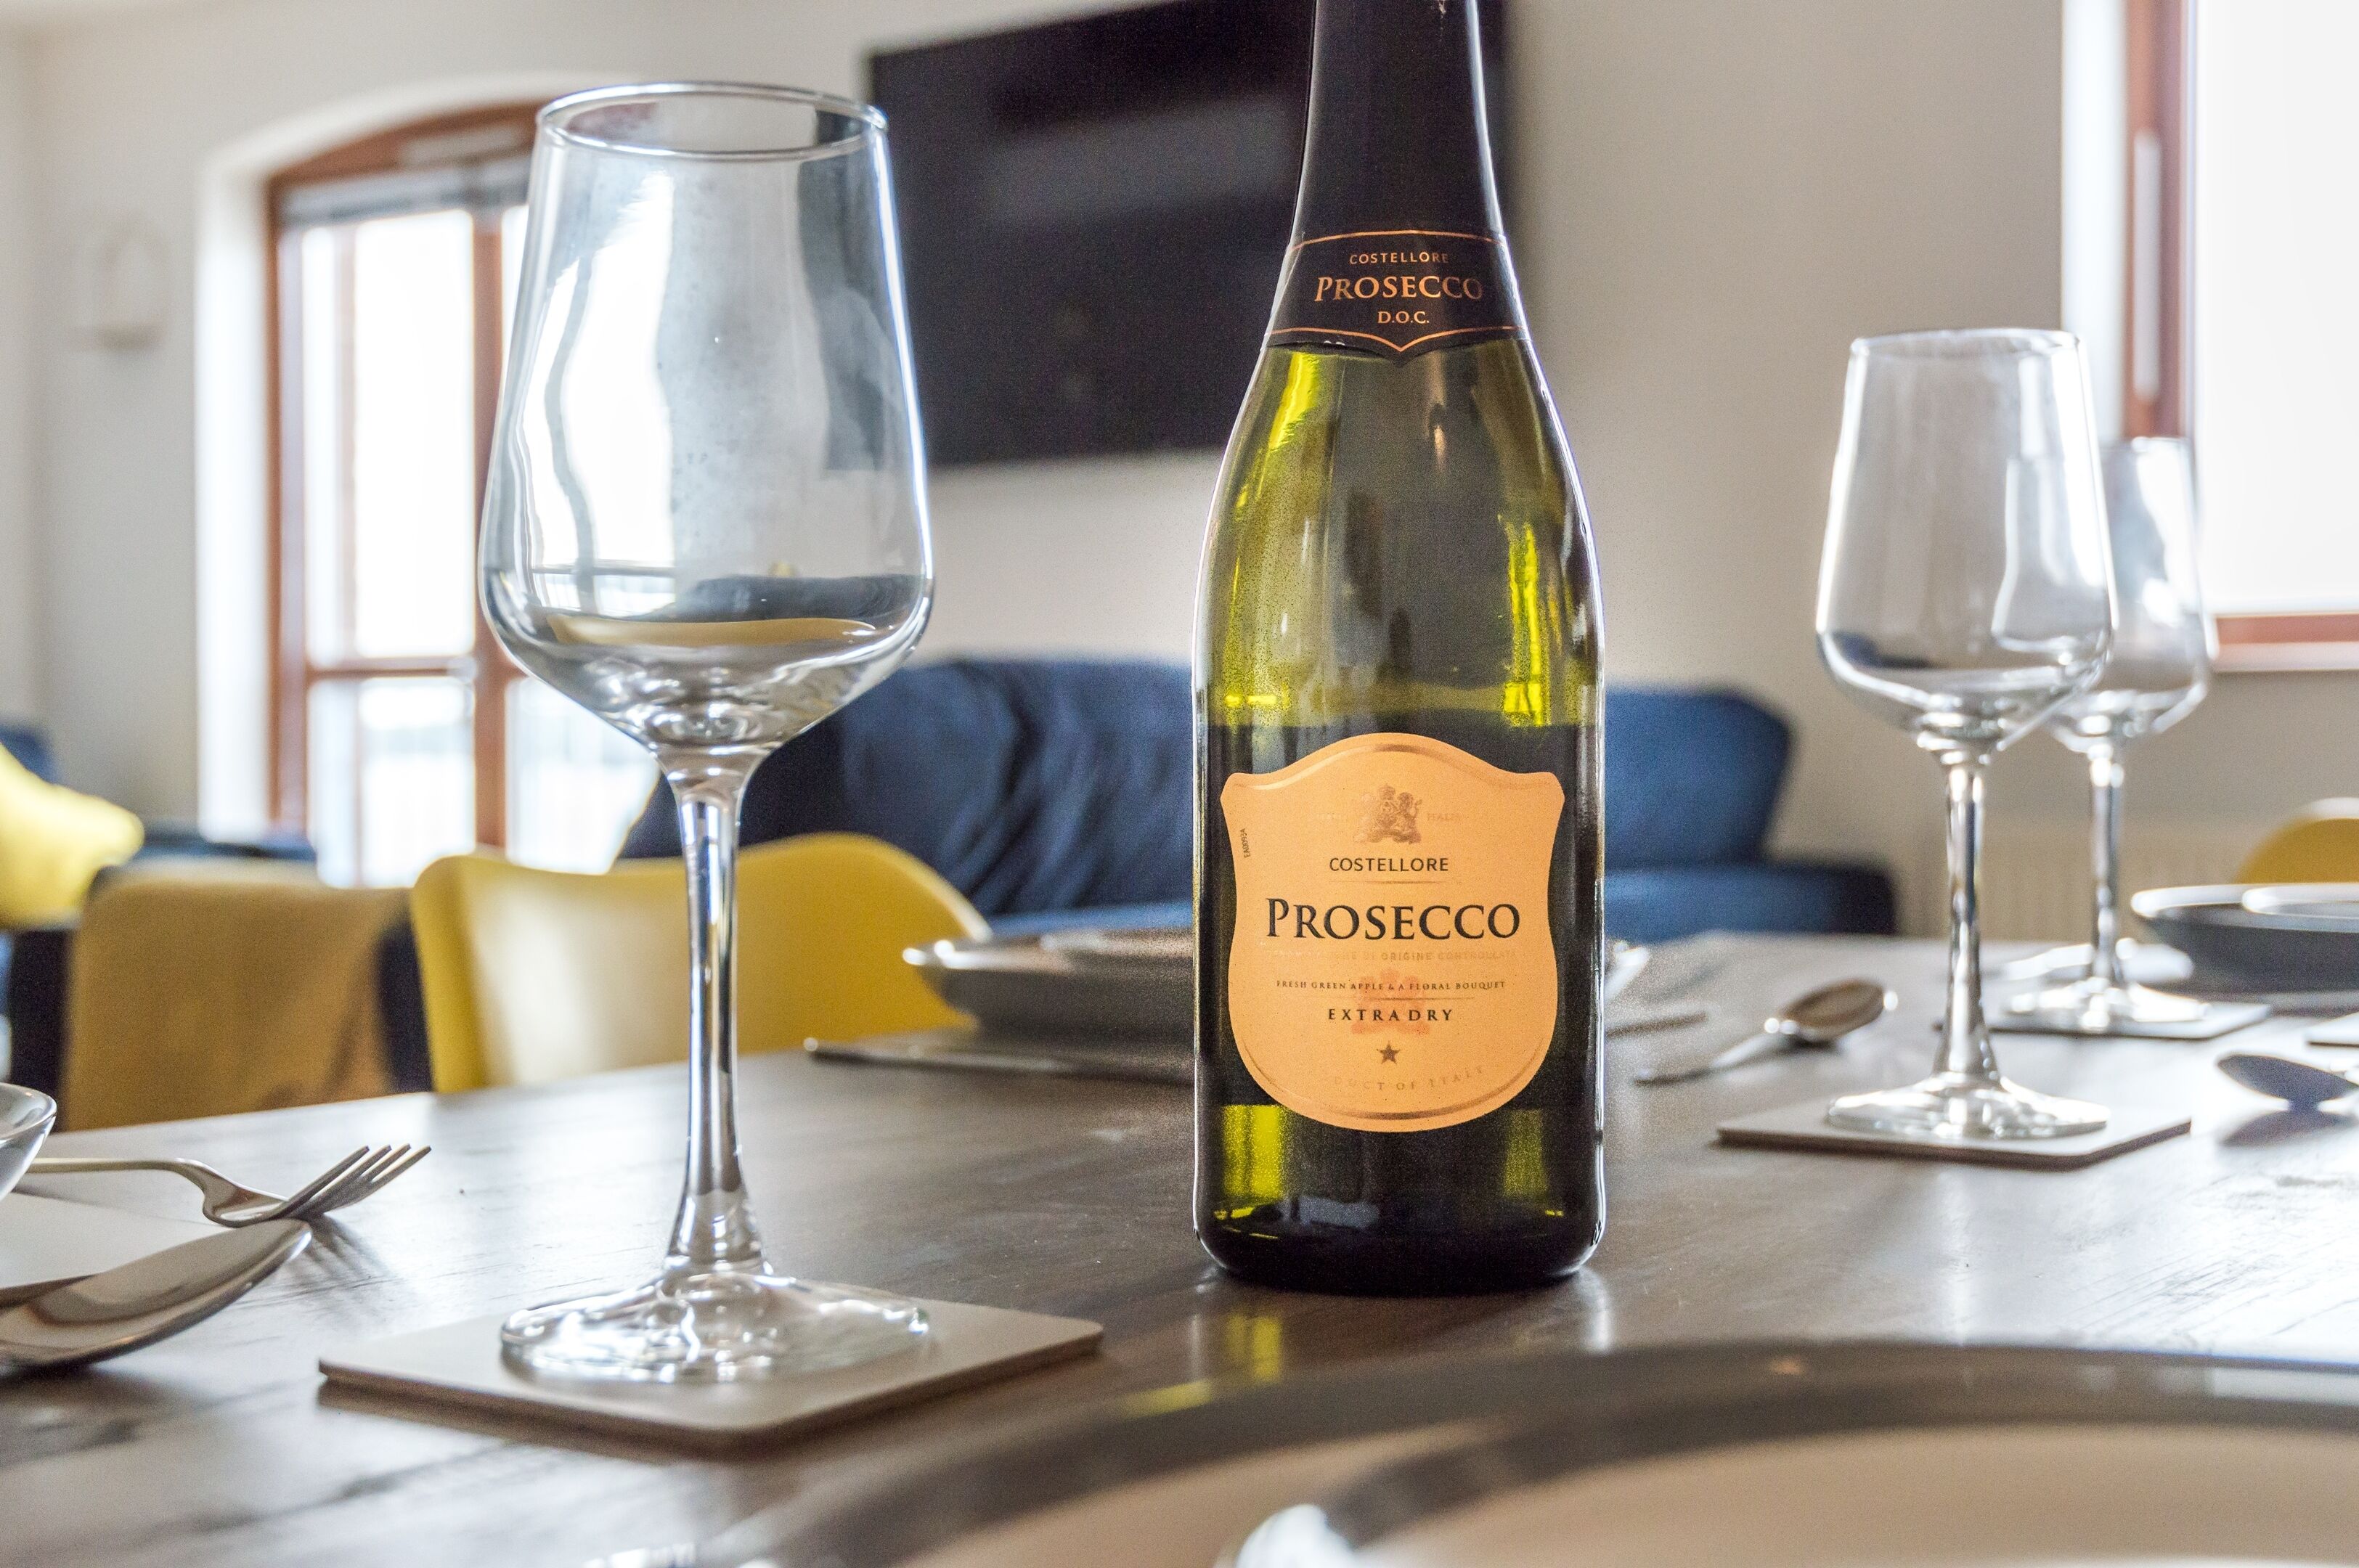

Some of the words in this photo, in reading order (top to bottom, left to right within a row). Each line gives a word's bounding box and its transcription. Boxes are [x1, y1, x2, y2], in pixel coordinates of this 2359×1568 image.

[1349, 251, 1449, 265] COSTELLORE
[1314, 275, 1483, 302] PROSECCO
[1377, 310, 1430, 324] D.O.C.
[1329, 857, 1449, 872] COSTELLORE
[1266, 898, 1520, 941] PROSECCO
[1380, 952, 1433, 961] ORIGINE
[1276, 980, 1307, 989] FRESH
[1311, 981, 1346, 990] GREEN
[1350, 982, 1385, 991] APPLE
[1409, 982, 1451, 991] FLORAL
[1456, 981, 1506, 991] BOUQUET
[1328, 1008, 1399, 1021] EXTRA
[1409, 1009, 1453, 1022] DRY
[1396, 1081, 1415, 1090] OF
